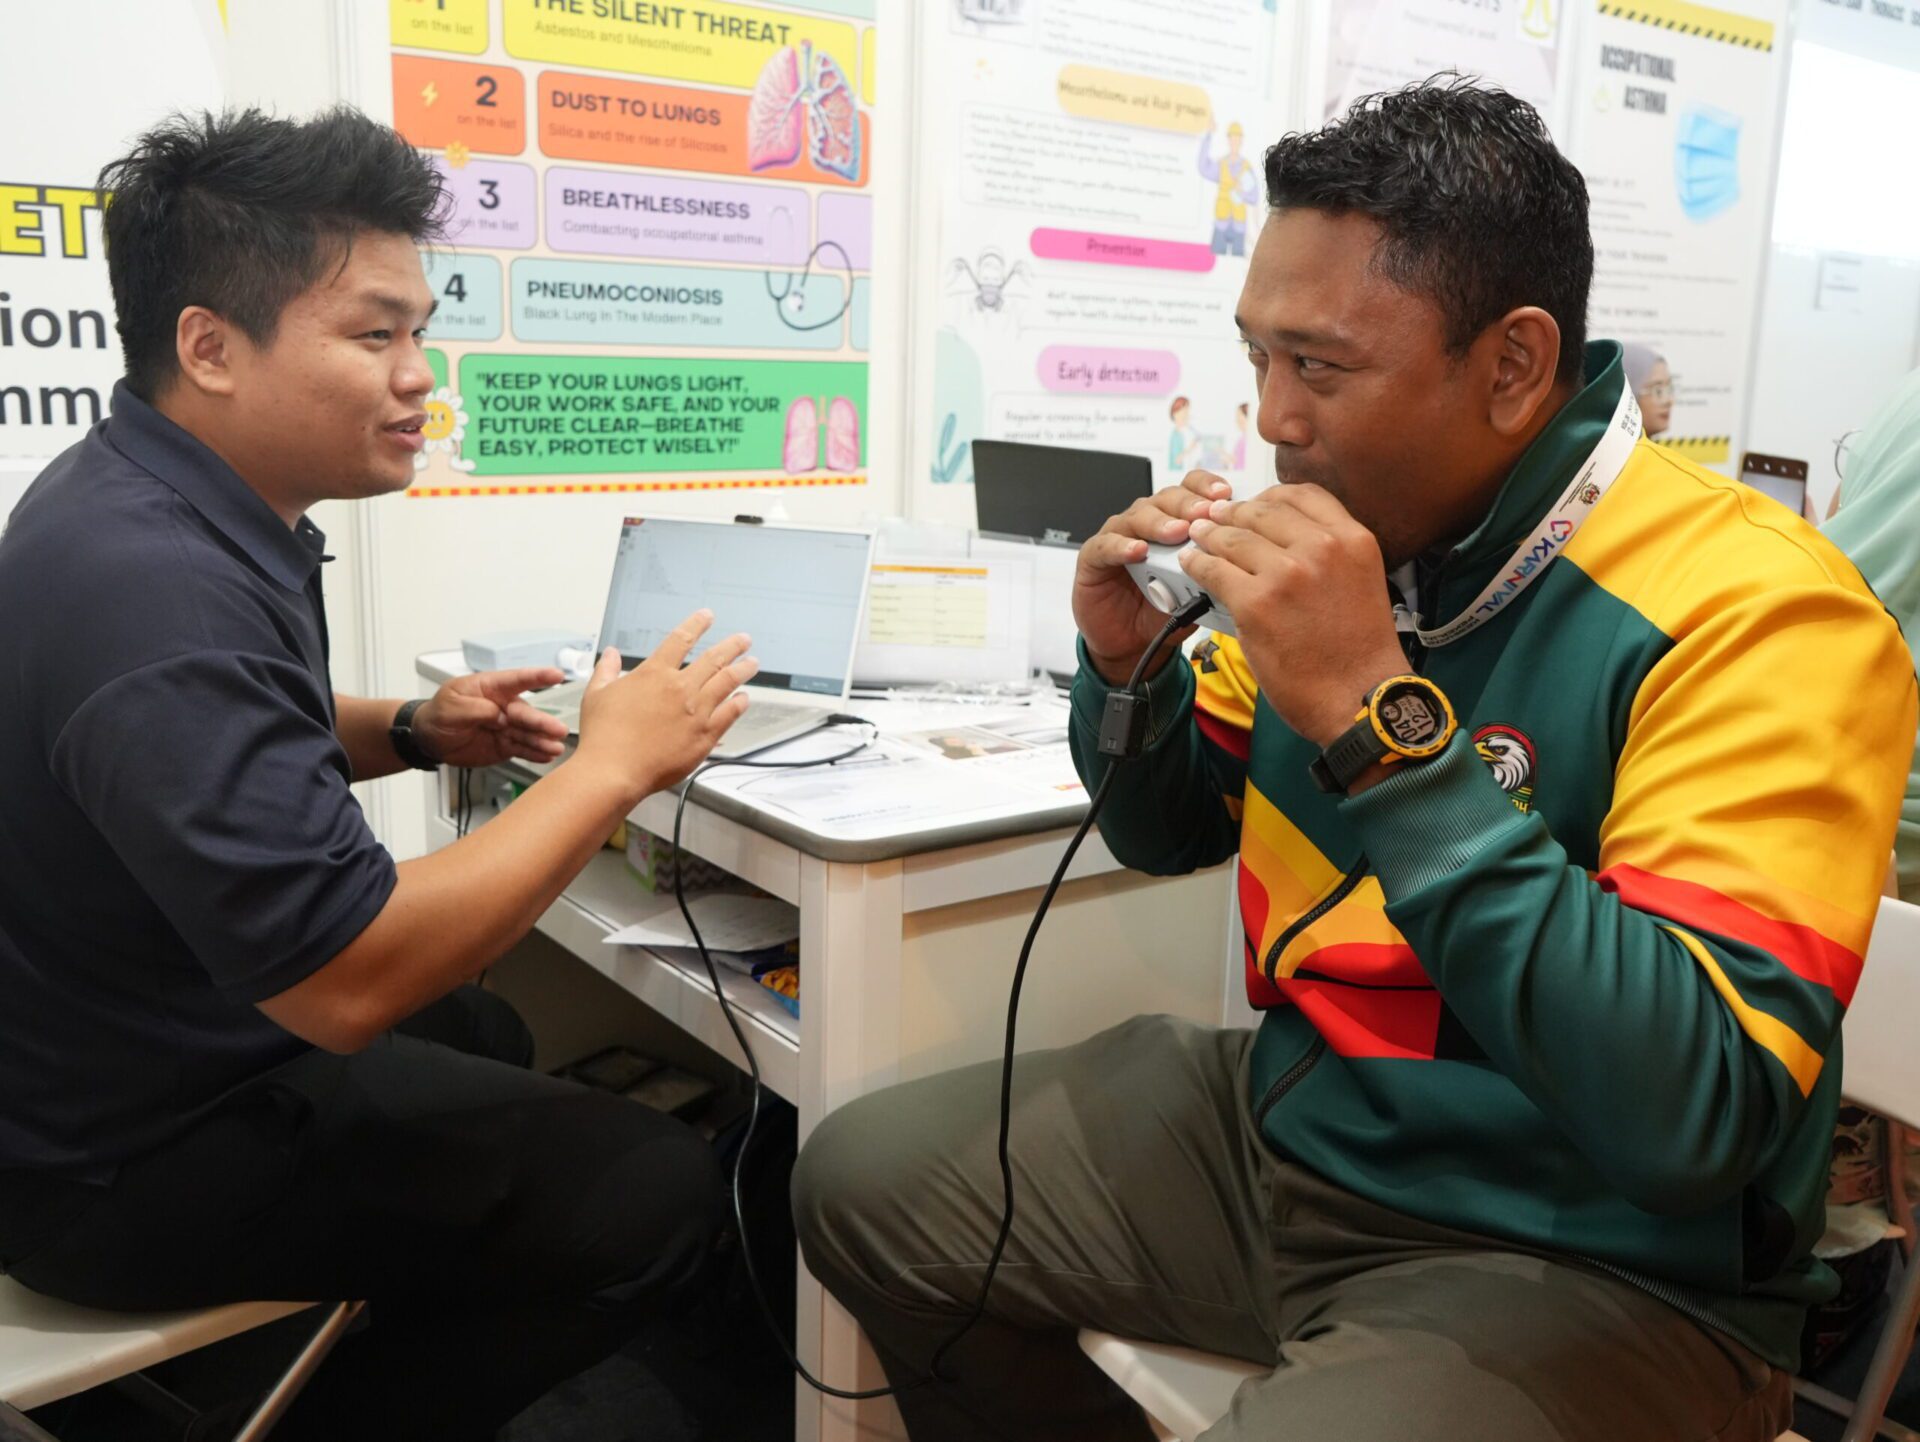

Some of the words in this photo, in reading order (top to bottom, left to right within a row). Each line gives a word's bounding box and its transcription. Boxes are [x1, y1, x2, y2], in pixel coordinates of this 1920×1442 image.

[411, 18, 428, 29] on
[431, 20, 452, 33] the
[455, 22, 474, 35] list
[593, 0, 686, 29] SILENT
[692, 10, 791, 45] THREAT
[534, 20, 597, 39] Asbestos
[600, 32, 624, 44] and
[627, 34, 712, 56] Mesothelioma
[475, 75, 498, 107] 2
[551, 90, 611, 113] DUST
[617, 98, 648, 117] TO
[652, 103, 722, 126] LUNGS
[457, 115, 472, 125] on
[476, 116, 496, 127] the
[499, 117, 517, 129] list
[548, 122, 584, 138] Silica
[588, 130, 612, 142] and
[615, 131, 636, 143] the
[639, 134, 661, 147] rise
[665, 136, 678, 147] of
[479, 179, 500, 210] 3
[562, 188, 751, 219] BREATHLESSNESS
[478, 219, 498, 230] the
[502, 219, 520, 231] list
[562, 220, 640, 240] Combacting
[643, 229, 720, 244] occupational
[722, 233, 764, 246] asthma
[444, 273, 468, 302] 4
[527, 280, 724, 306] PNEUMOCONIOSIS
[446, 314, 465, 326] the
[468, 314, 486, 326] list
[523, 306, 560, 320] Black
[565, 308, 598, 324] Lung
[600, 309, 613, 322] In
[615, 310, 639, 323] The
[642, 311, 688, 325] Modern
[691, 313, 723, 326] Place
[548, 373, 608, 391] YOUR
[613, 374, 683, 392] LUNGS
[687, 375, 750, 394] LIGHT,
[1057, 359, 1094, 388] Early
[1097, 360, 1160, 383] detection
[477, 395, 542, 412] YOUR
[547, 395, 616, 412] WORK
[621, 396, 680, 414] SAFE,
[682, 396, 725, 413] AND
[729, 396, 781, 413] YOUR
[478, 417, 566, 434] FUTURE
[479, 438, 543, 458] EASY,
[548, 438, 648, 456] PROTECT
[1475, 537, 1555, 613] KARNIVAL
[1395, 719, 1418, 740] 04
[1411, 711, 1433, 731] 12
